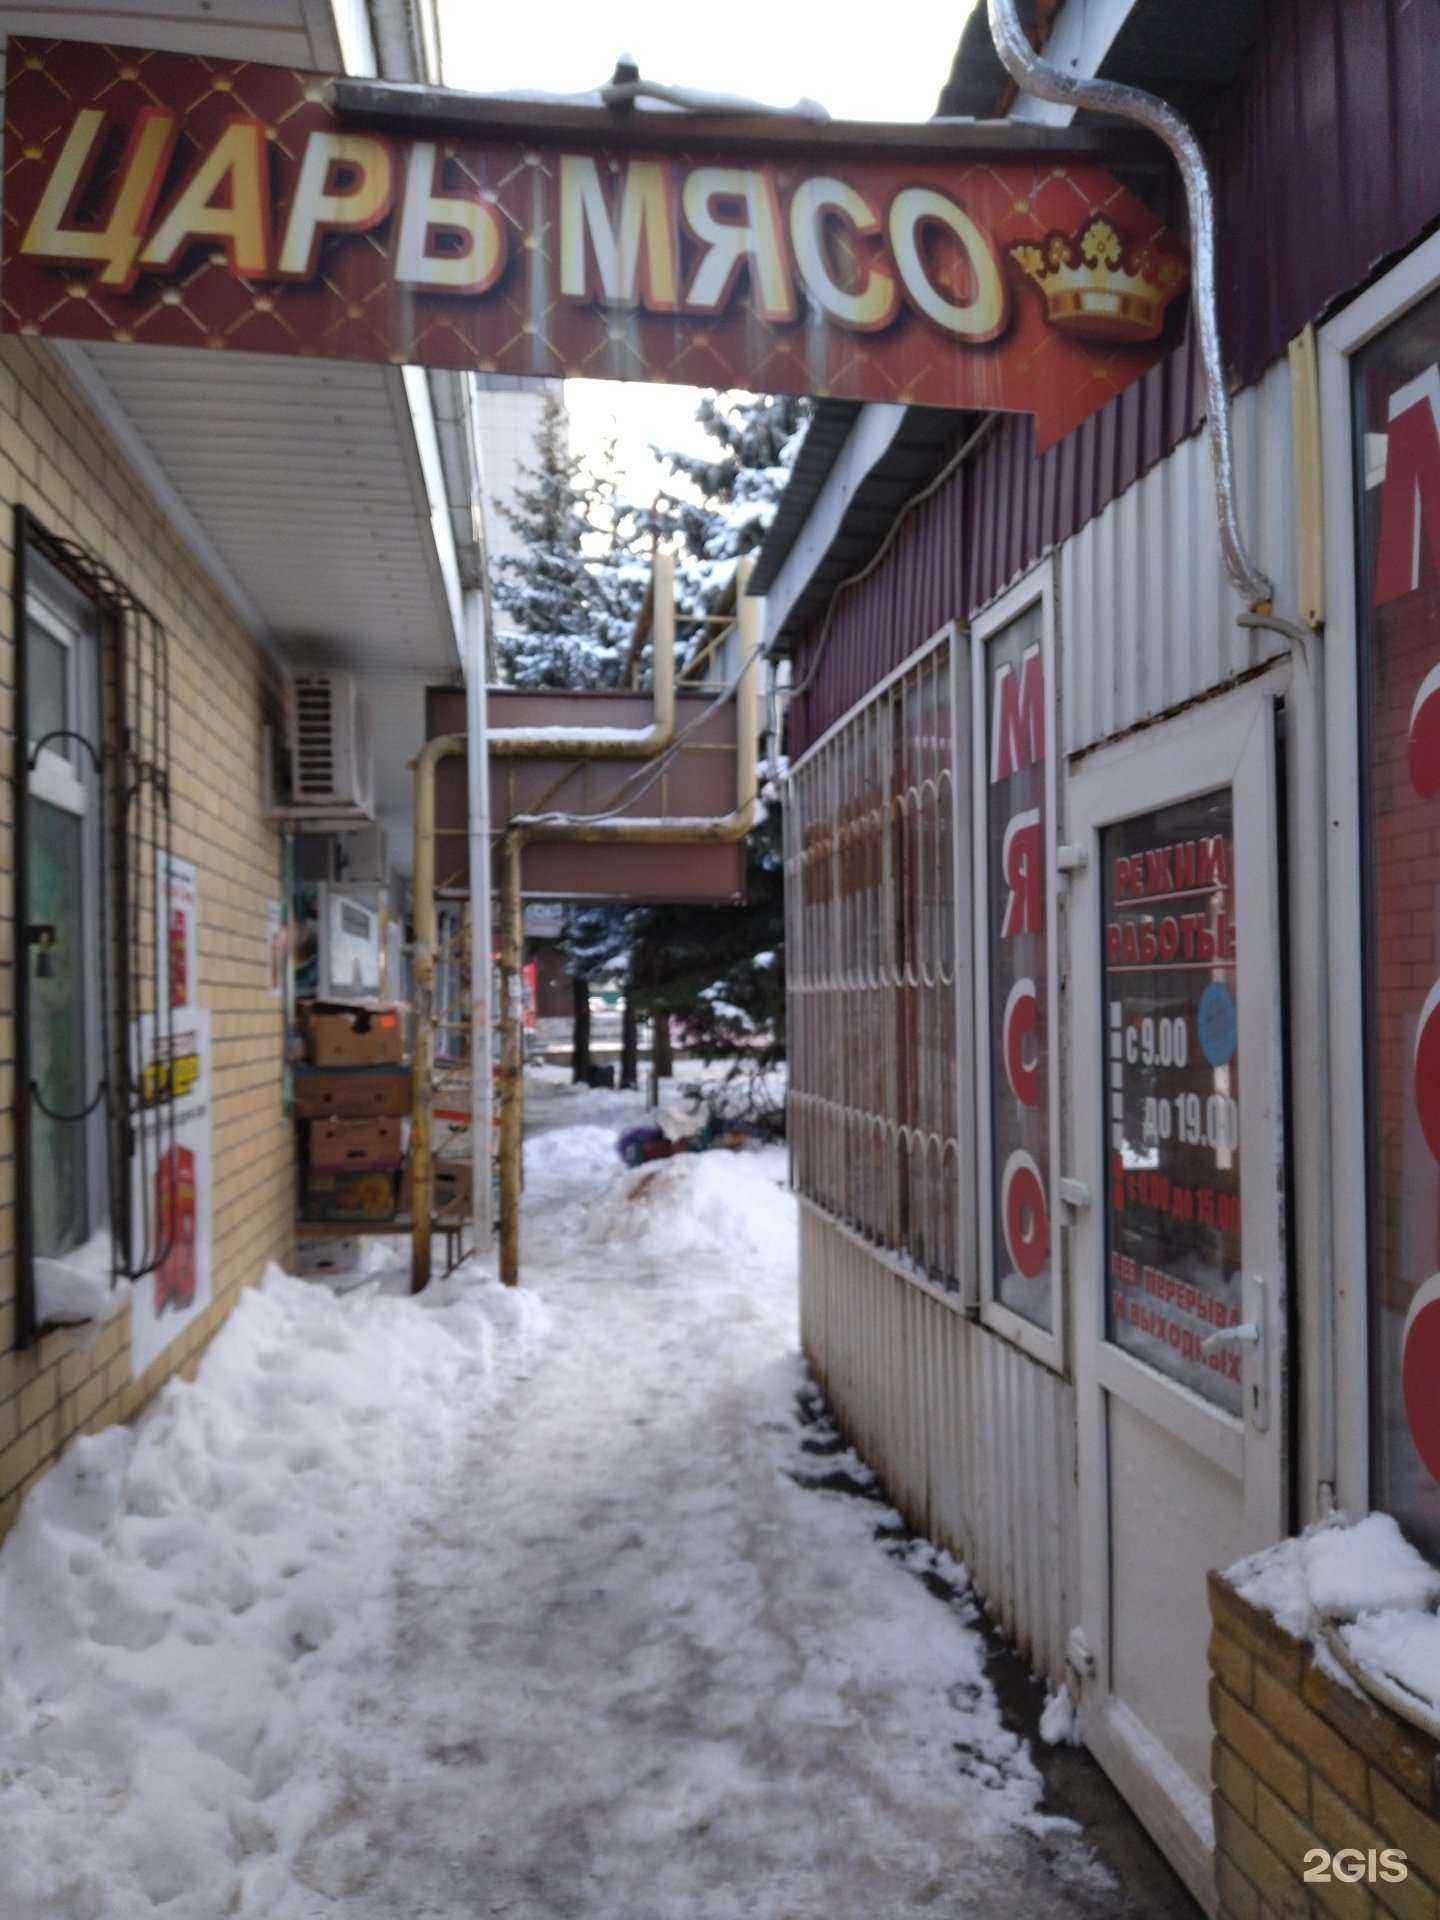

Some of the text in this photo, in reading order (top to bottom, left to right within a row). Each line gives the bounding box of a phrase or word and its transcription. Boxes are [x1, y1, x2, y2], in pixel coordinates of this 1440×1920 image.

[20, 106, 1010, 343] ЦАРЬ МЯСО
[1113, 835, 1228, 898] РЕЖИМ
[1141, 1017, 1188, 1068] 9.00
[1175, 1092, 1238, 1151] 19.00
[1143, 1264, 1240, 1330] ПЕРЕРЫВА
